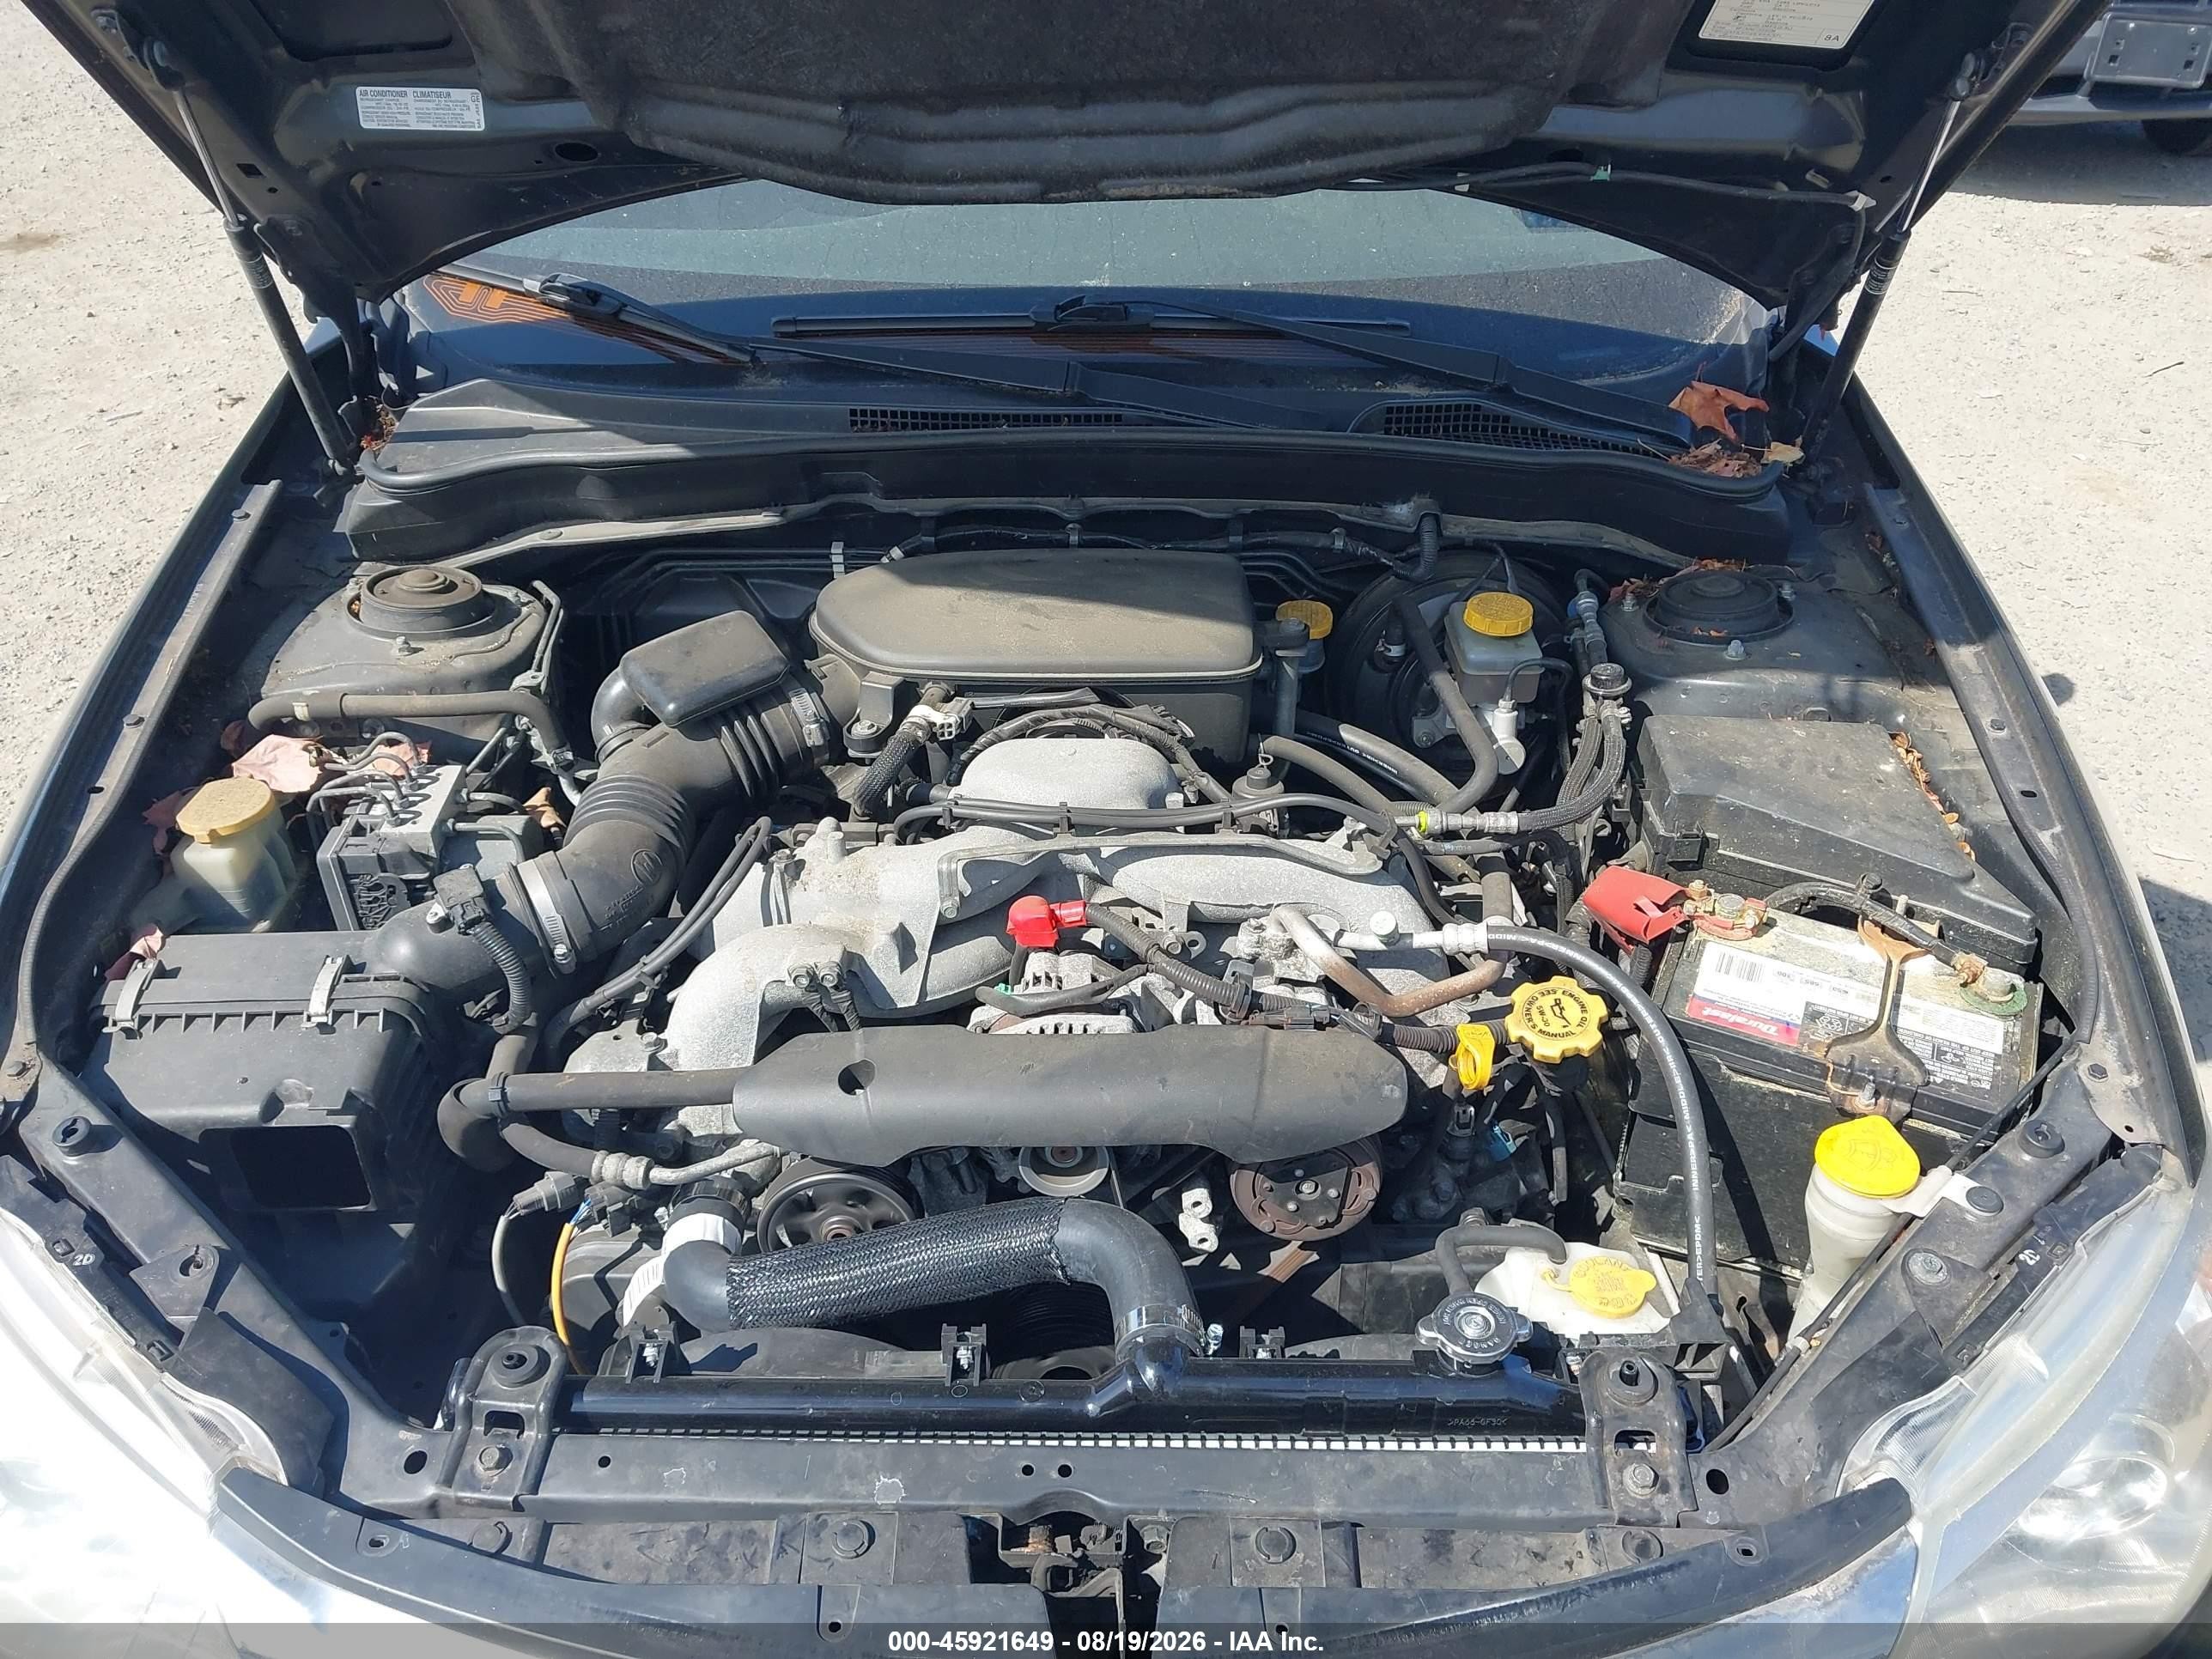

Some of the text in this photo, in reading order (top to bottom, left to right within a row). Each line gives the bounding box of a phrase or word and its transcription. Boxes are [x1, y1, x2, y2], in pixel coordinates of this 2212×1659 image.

[412, 90, 452, 99] CLIMATISEUR
[1537, 988, 1559, 998] SEE
[1562, 989, 1588, 1028] ENGINE OIL
[1702, 1006, 1778, 1036] Duralast
[1537, 1028, 1577, 1039] MANUAL
[72, 1253, 96, 1267] 2D
